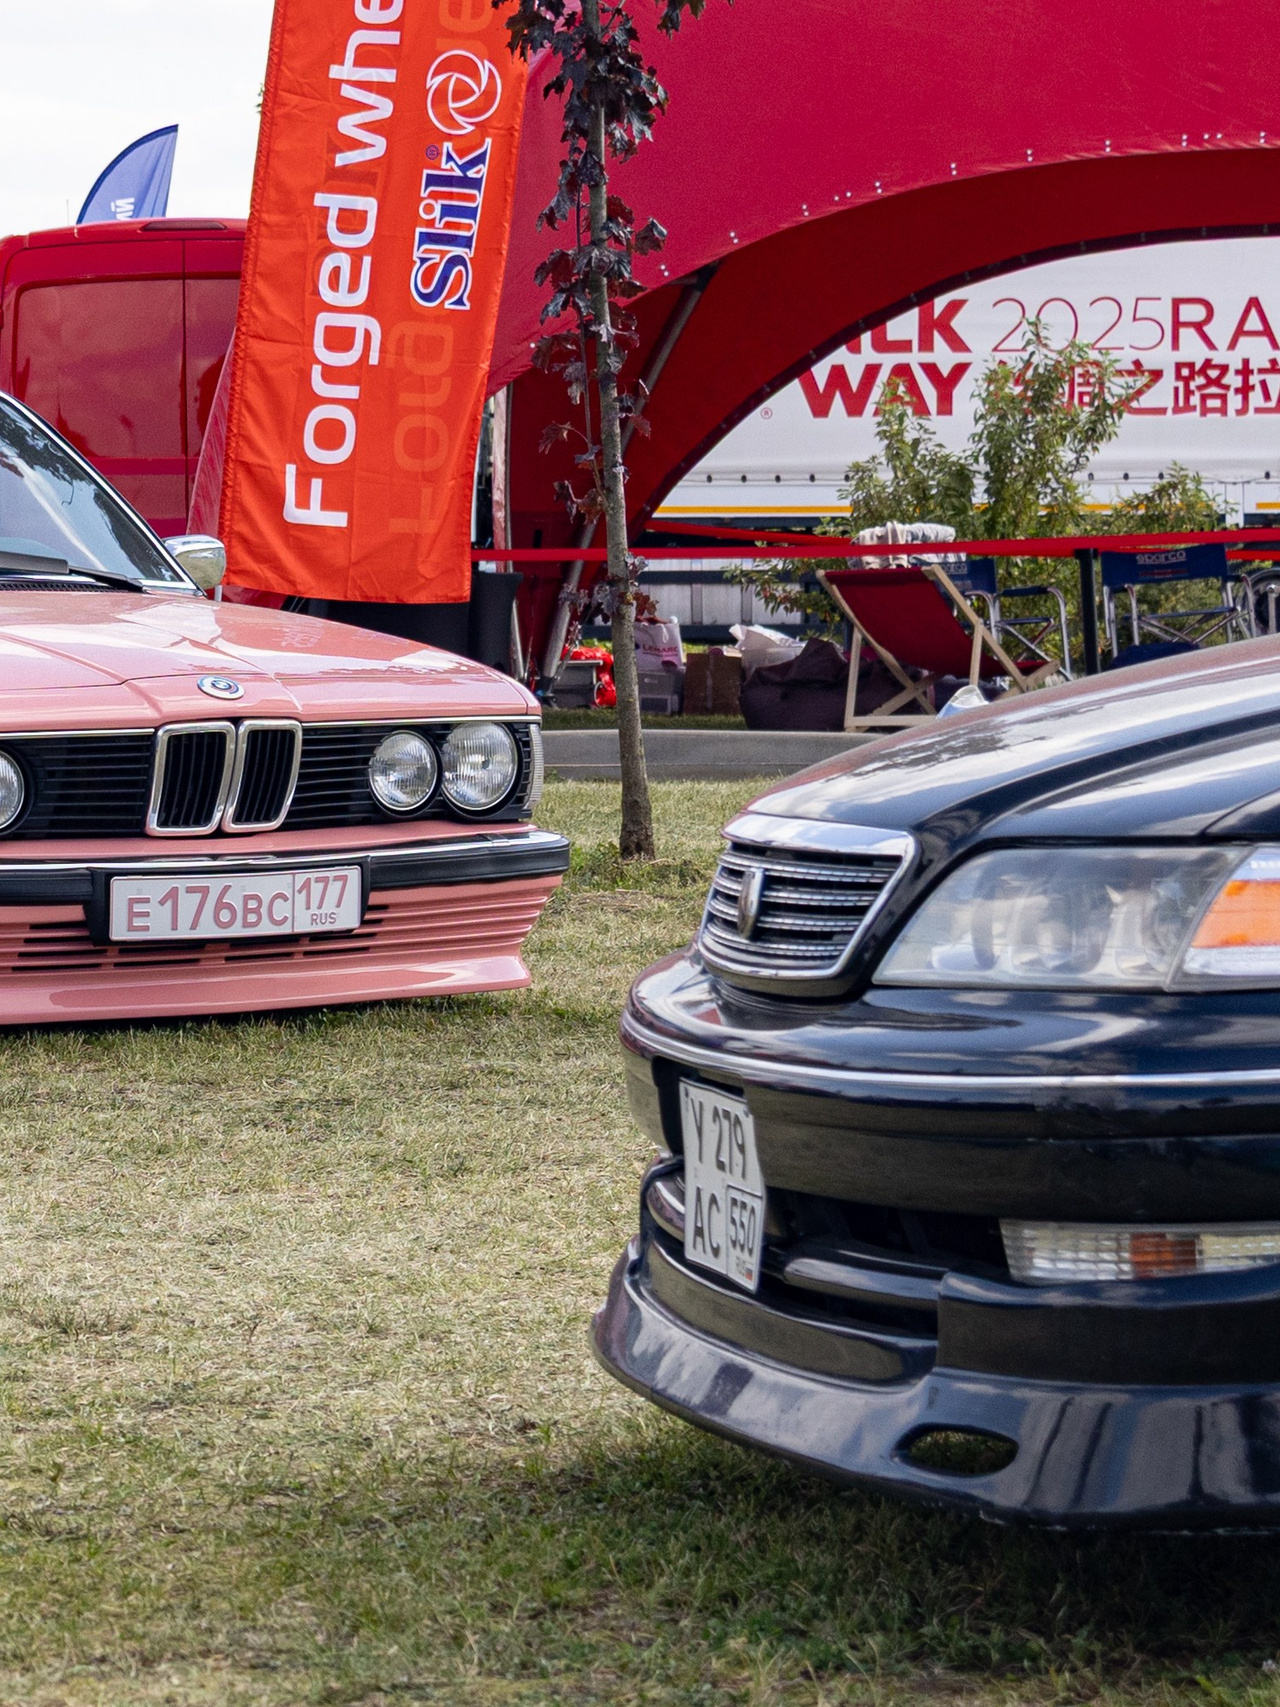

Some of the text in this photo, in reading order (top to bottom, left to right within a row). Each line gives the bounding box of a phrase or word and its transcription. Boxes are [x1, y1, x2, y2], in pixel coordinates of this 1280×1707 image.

[410, 138, 492, 311] Slik
[282, 193, 383, 528] Forged
[798, 362, 973, 419] WAY
[297, 874, 349, 910] 177
[310, 911, 337, 926] RUS
[712, 1105, 747, 1180] 279
[729, 1197, 756, 1256] 550
